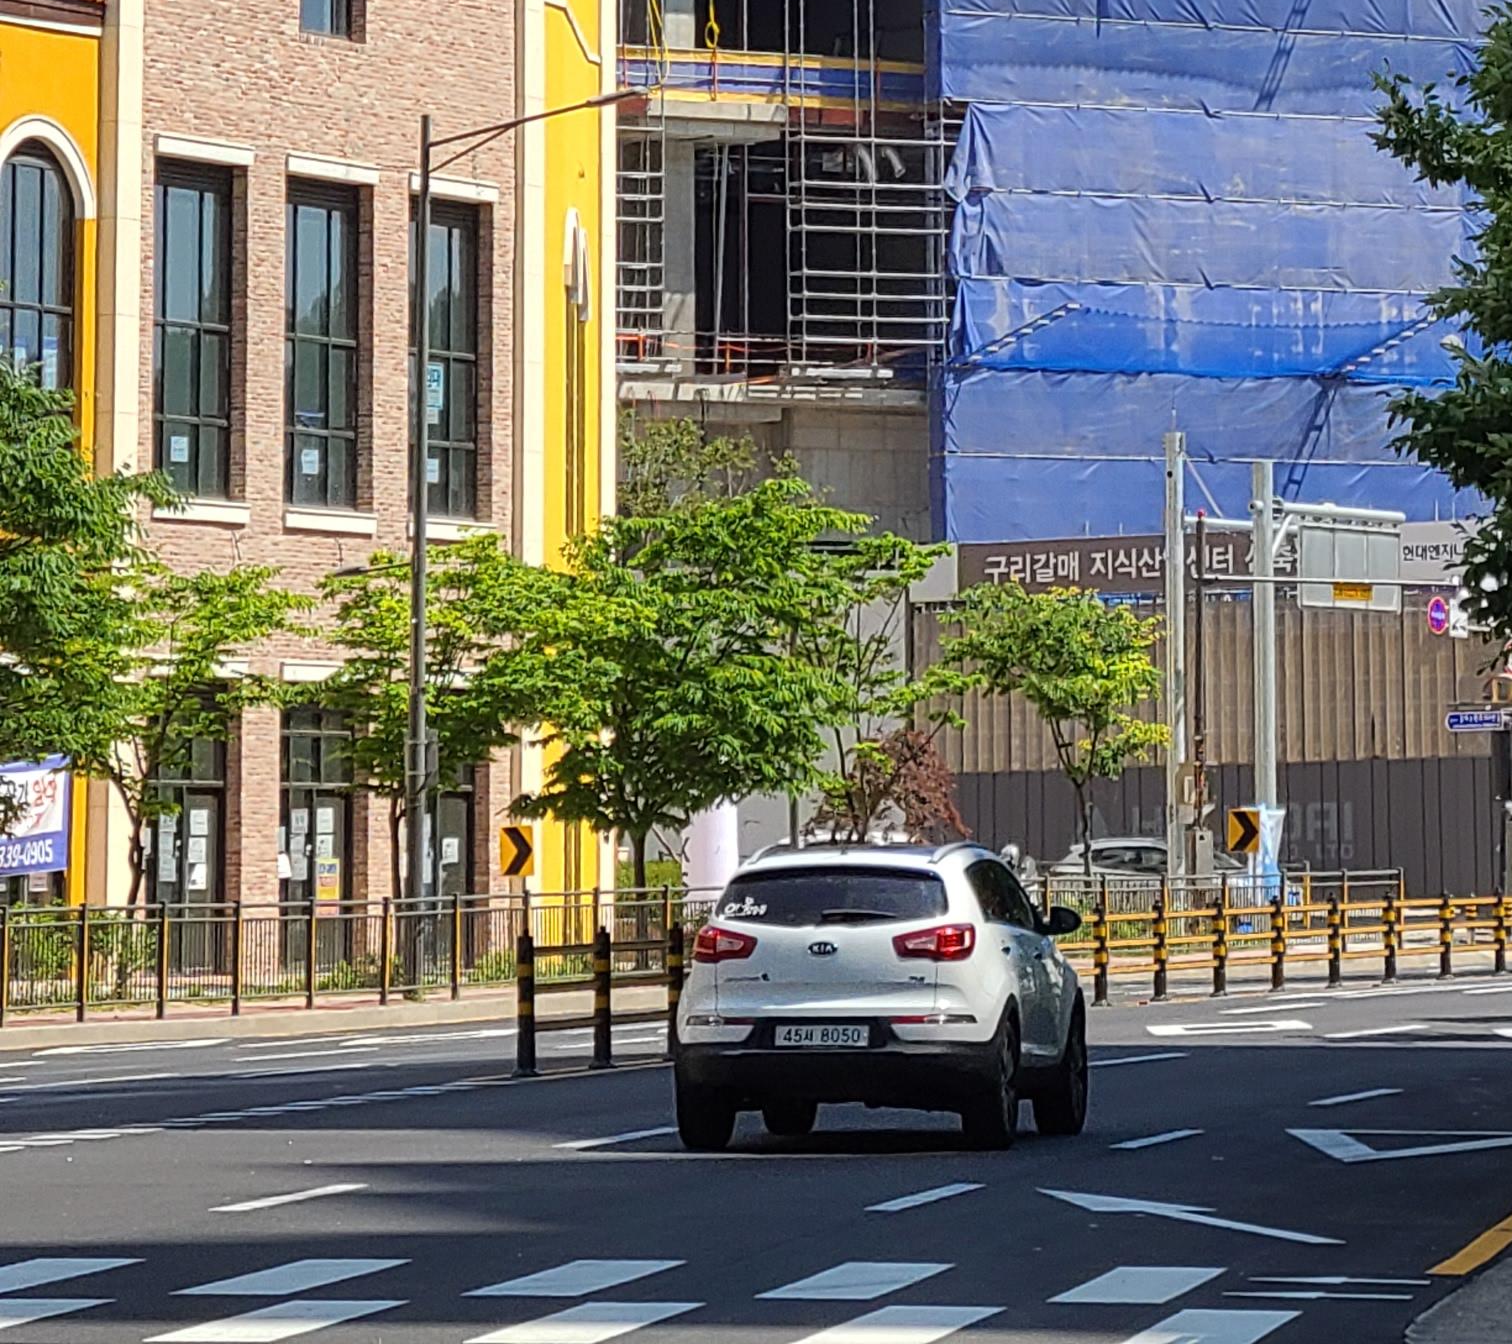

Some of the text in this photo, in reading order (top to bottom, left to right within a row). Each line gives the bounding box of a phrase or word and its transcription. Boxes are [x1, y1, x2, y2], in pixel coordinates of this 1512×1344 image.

[984, 550, 1080, 585] 구리갈매
[1090, 543, 1234, 580] 지식산센터
[812, 944, 834, 953] KIA
[820, 1028, 861, 1043] 8050
